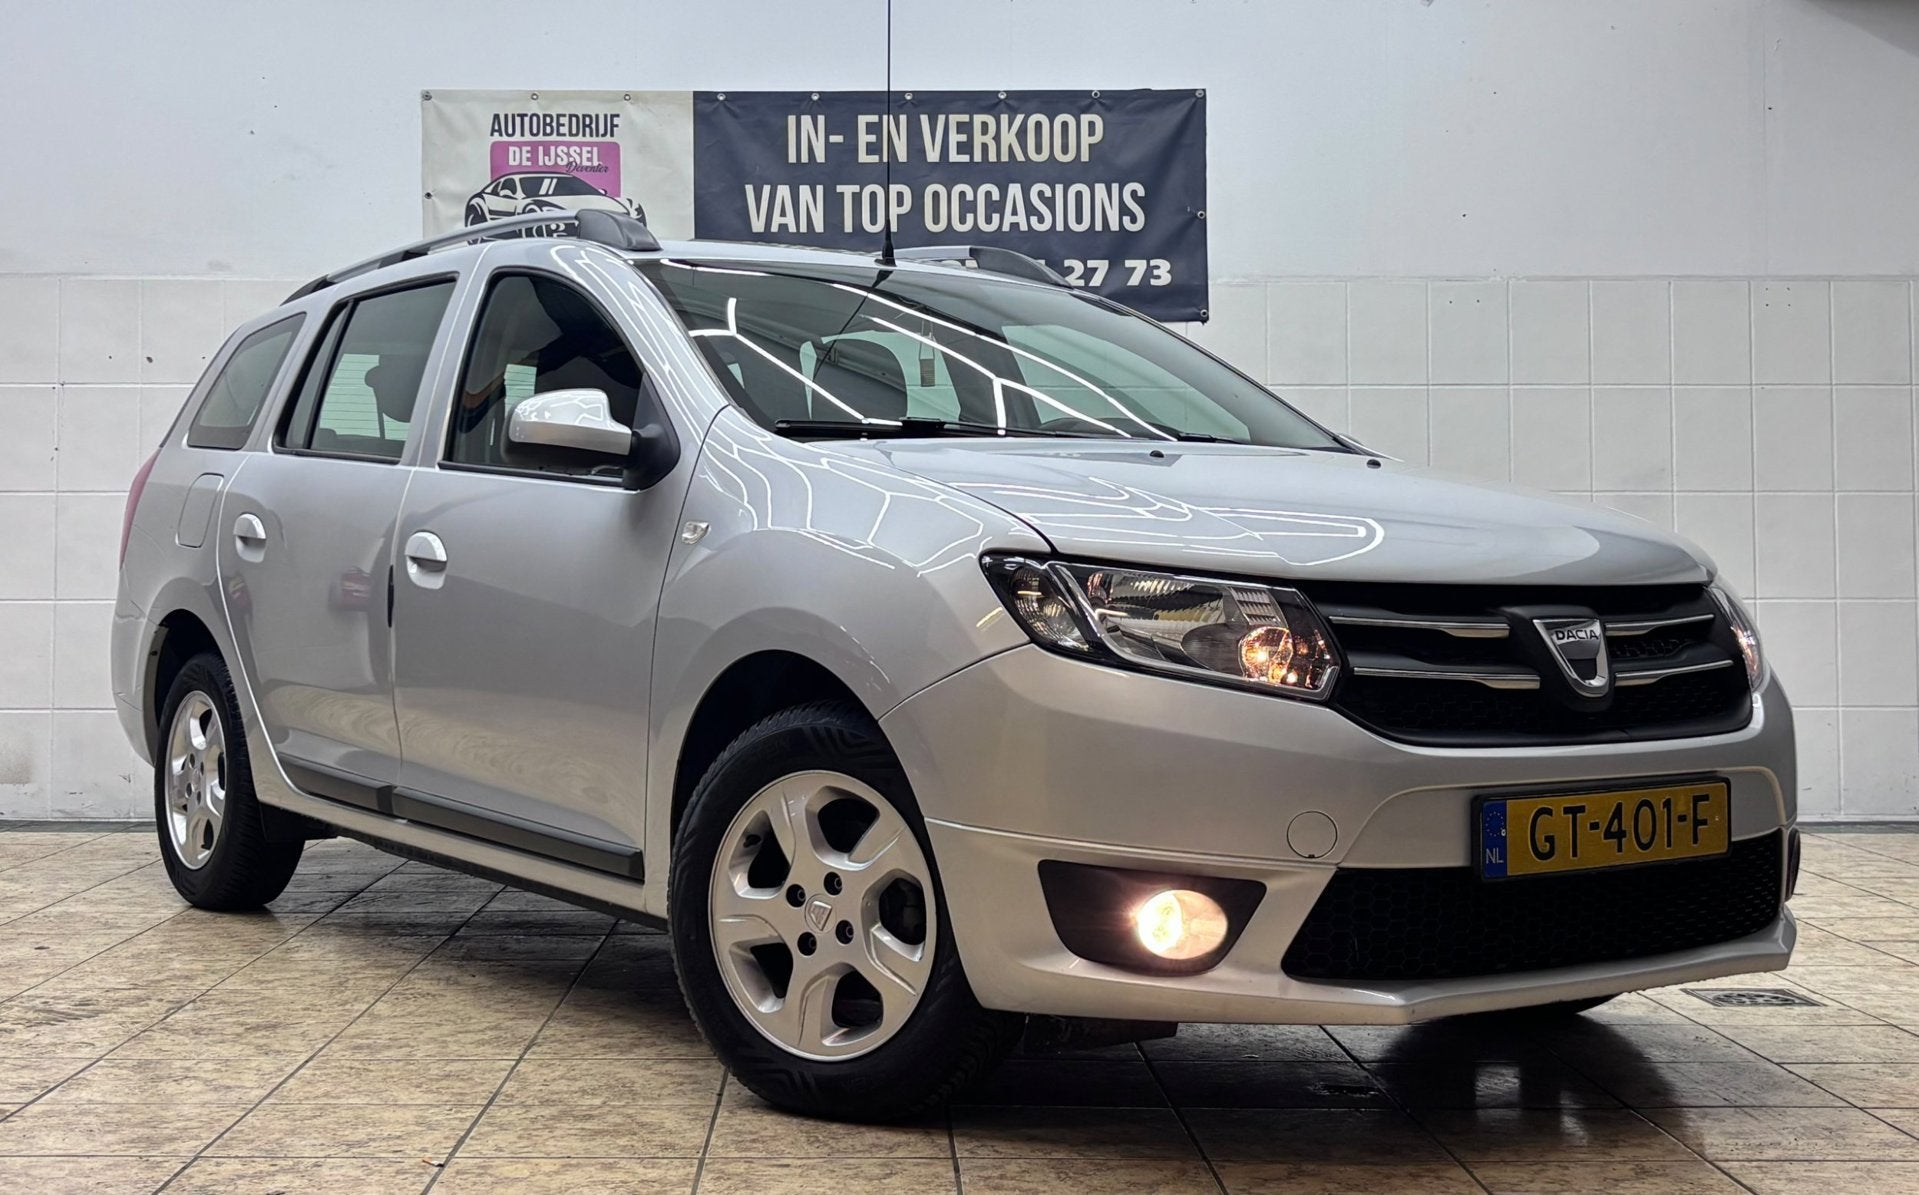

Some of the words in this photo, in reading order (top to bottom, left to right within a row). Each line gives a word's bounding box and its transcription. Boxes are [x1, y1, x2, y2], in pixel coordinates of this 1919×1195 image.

[490, 112, 620, 138] AUTOBEDRIJF
[787, 114, 844, 164] IN-
[857, 114, 908, 164] EN
[920, 113, 1104, 163] VERKOOP
[508, 145, 532, 166] DE
[538, 145, 602, 167] IJSSEL
[745, 184, 824, 233] VAN
[836, 183, 912, 233] TOP
[924, 182, 1146, 233] OCCASIONS
[1063, 259, 1109, 287] 27
[1124, 258, 1172, 286] 73
[1554, 628, 1600, 642] DACIA
[1529, 794, 1710, 861] GT-401-F
[1485, 847, 1504, 864] NL
